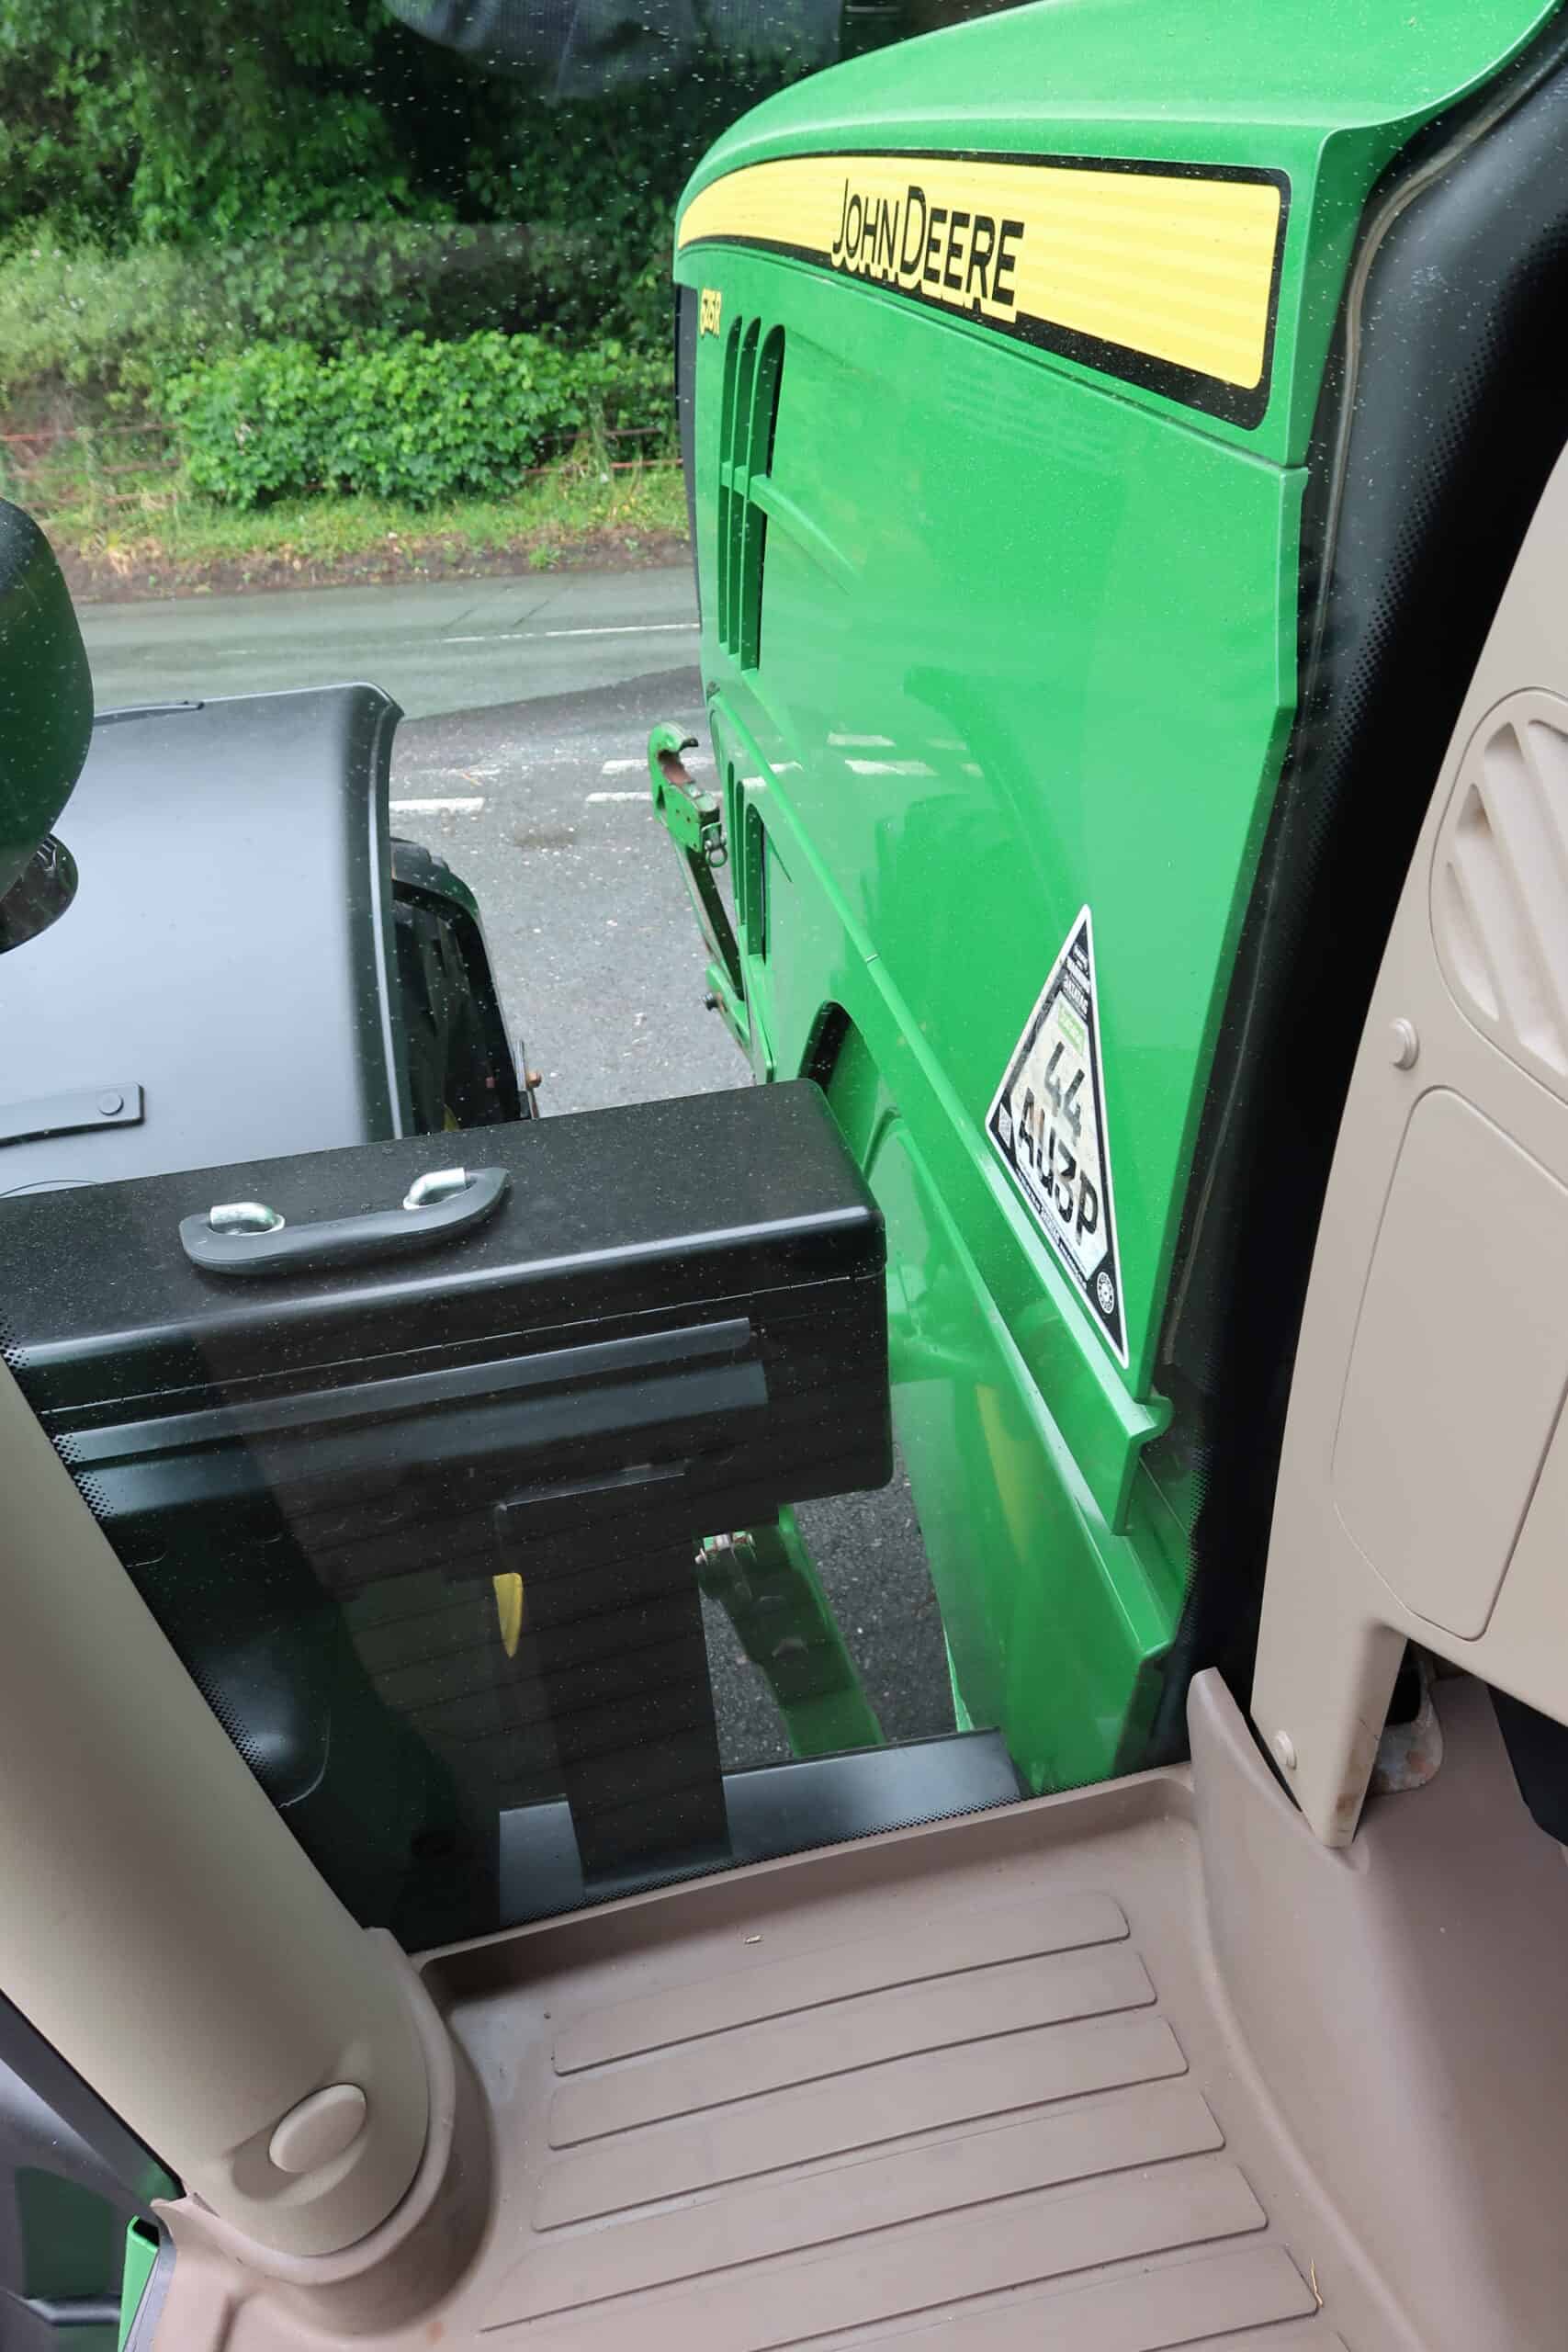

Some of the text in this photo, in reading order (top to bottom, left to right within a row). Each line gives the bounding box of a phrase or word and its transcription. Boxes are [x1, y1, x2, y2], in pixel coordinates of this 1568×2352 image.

[832, 177, 1024, 307] JOHN DEERE
[1018, 1087, 1098, 1245] AU3P
